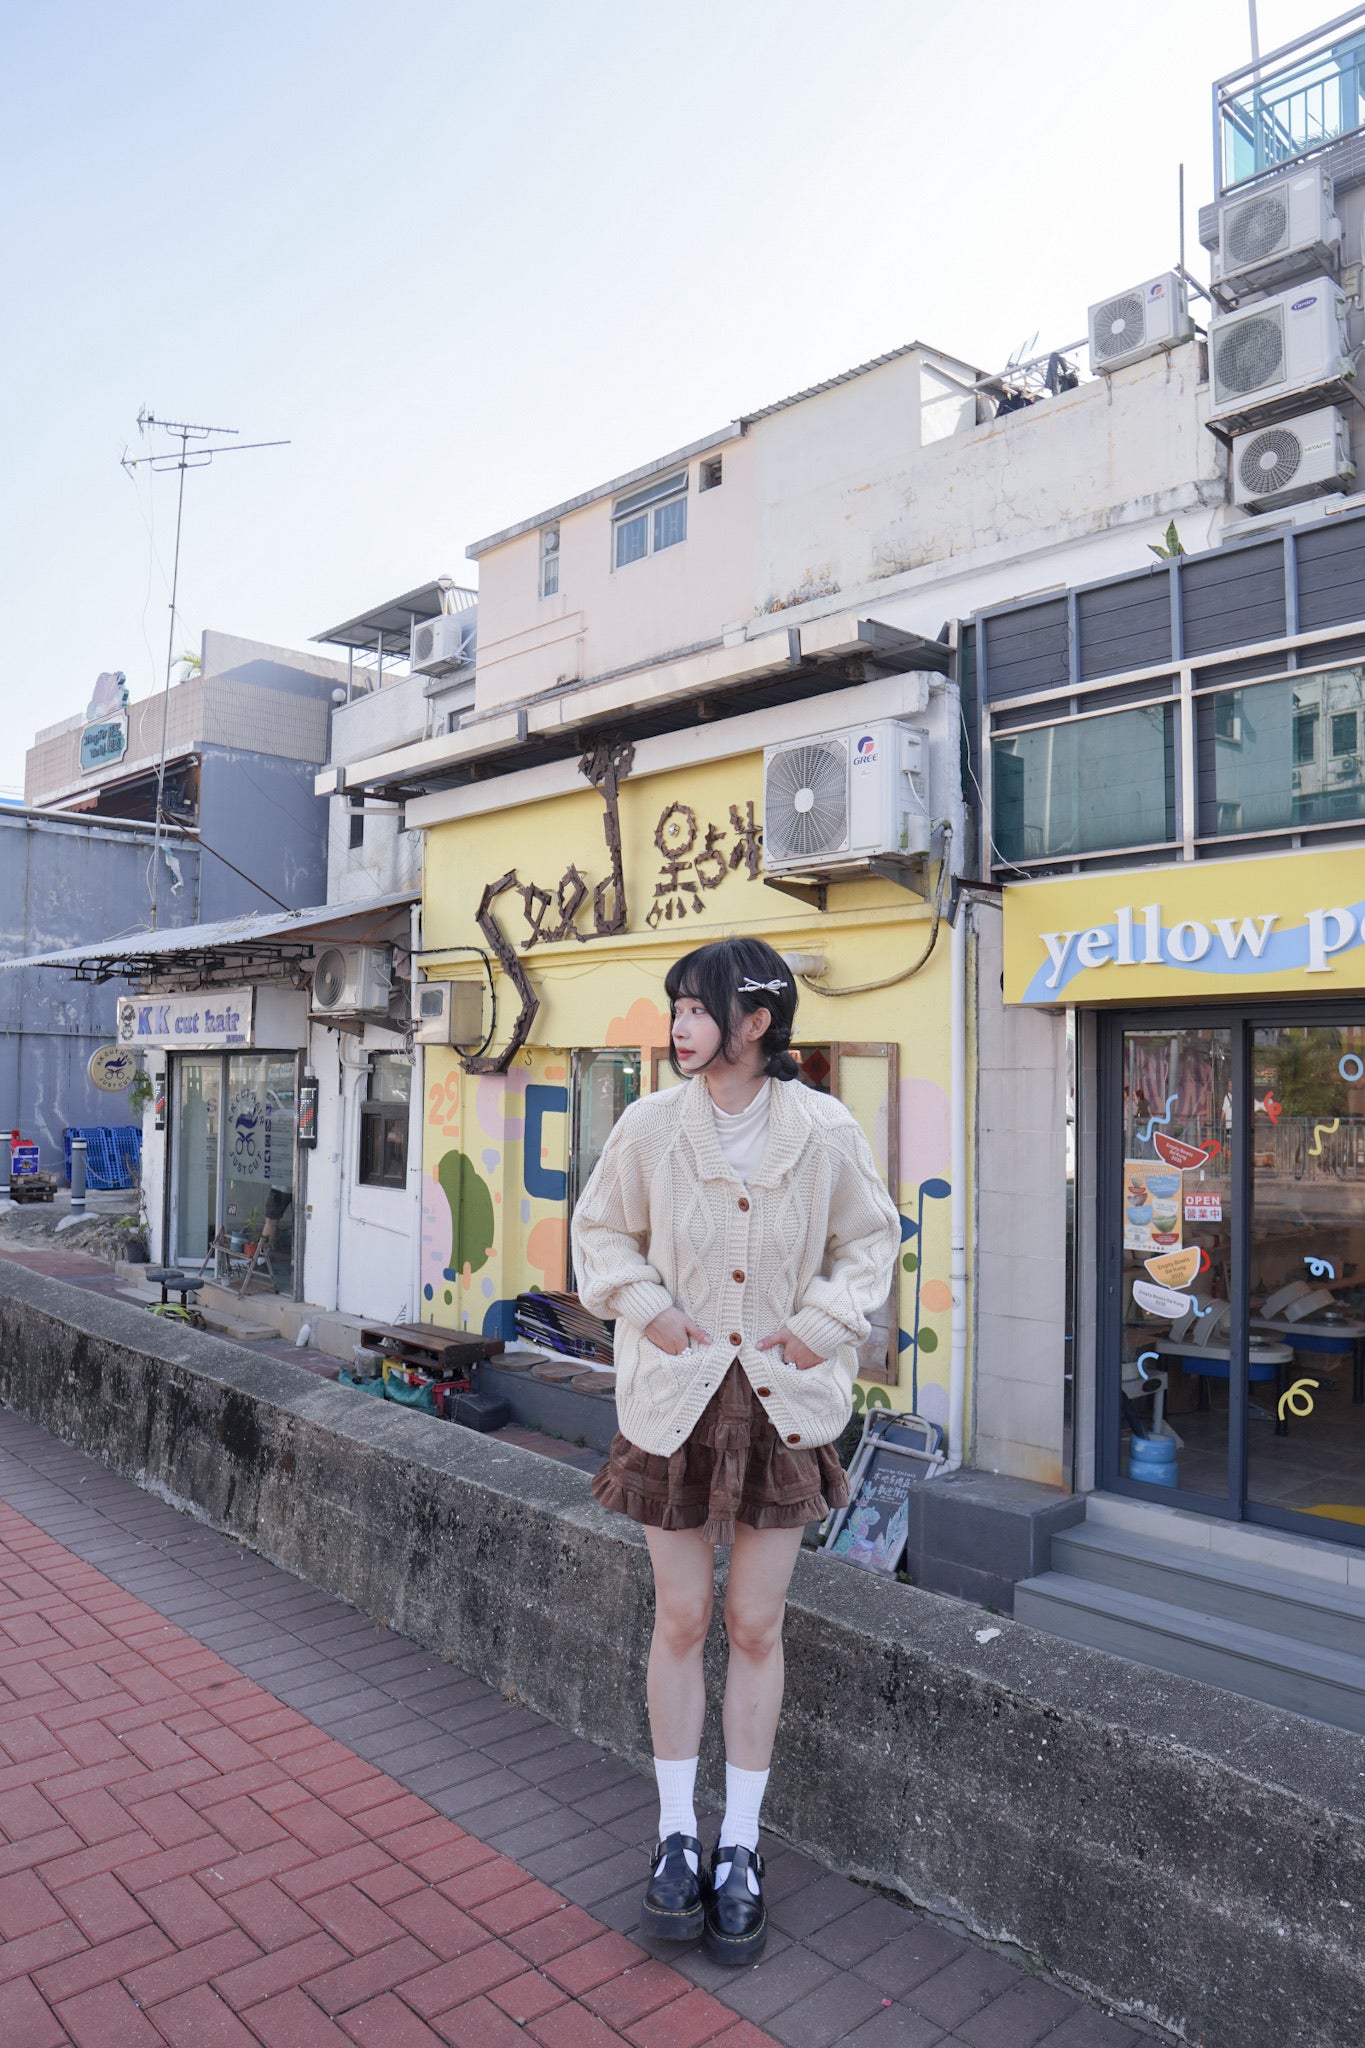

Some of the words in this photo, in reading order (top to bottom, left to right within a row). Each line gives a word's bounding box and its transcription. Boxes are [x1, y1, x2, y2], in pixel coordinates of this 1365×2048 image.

[1304, 441, 1331, 453] HITACHI
[853, 753, 879, 766] GREE
[1039, 903, 1281, 989] yellow
[1303, 907, 1365, 974] p
[175, 1012, 200, 1034] cut
[204, 1006, 240, 1033] hair
[1185, 1195, 1220, 1206] OPEN
[1186, 1207, 1221, 1220] 營業中
